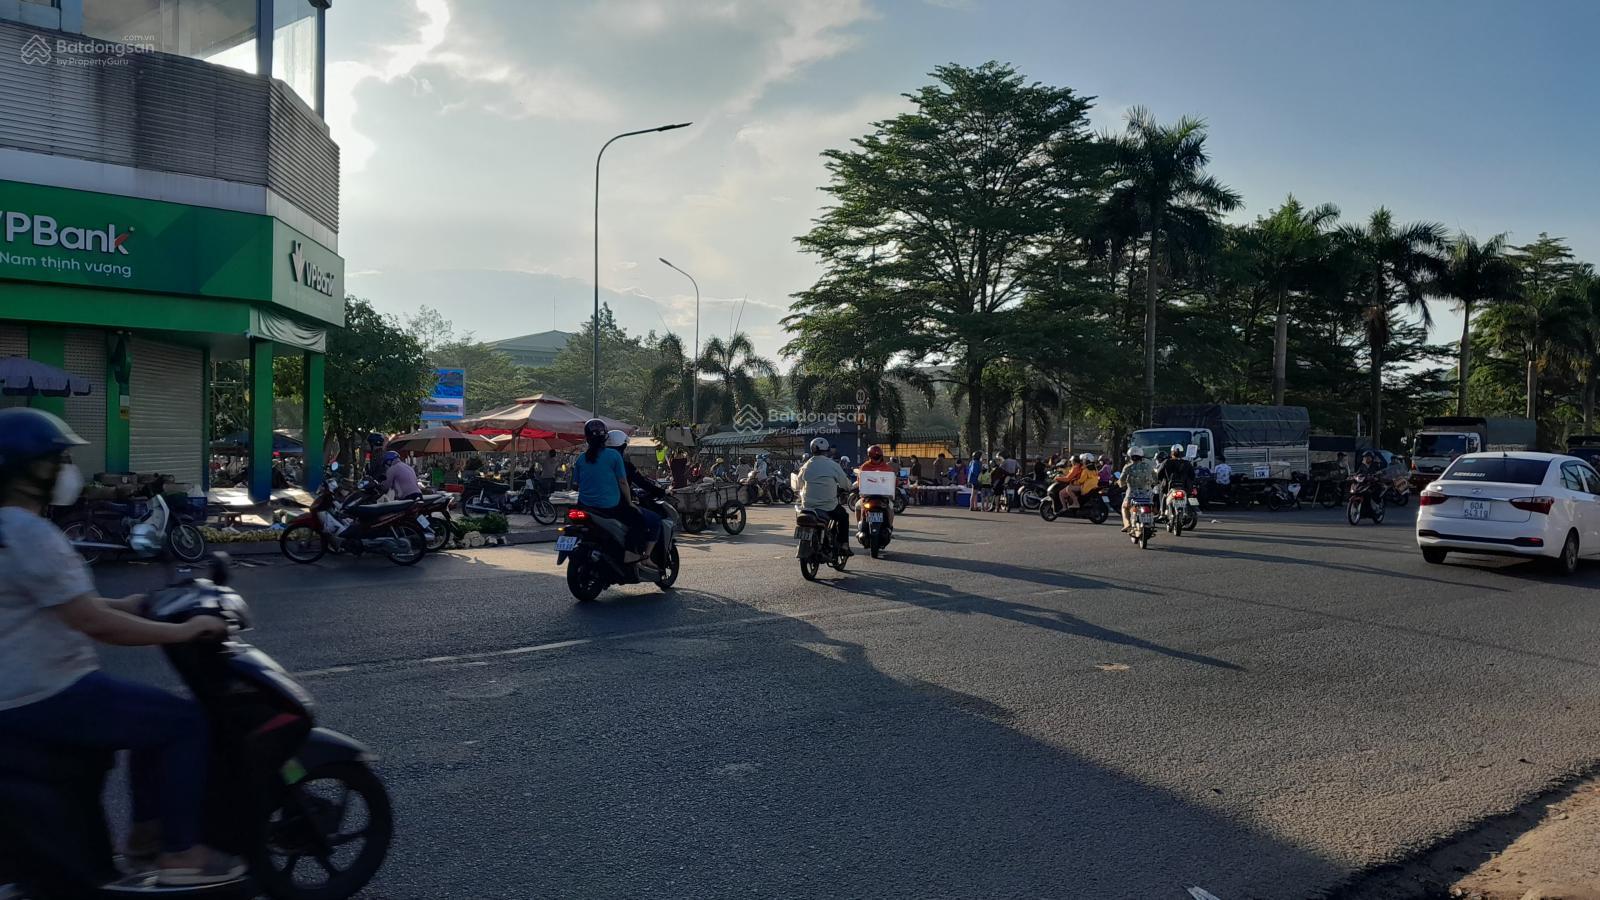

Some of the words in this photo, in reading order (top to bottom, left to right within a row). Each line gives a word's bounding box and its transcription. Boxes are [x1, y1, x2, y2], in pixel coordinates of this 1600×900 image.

[0, 210, 129, 255] PBank
[41, 256, 80, 271] thịnh
[85, 261, 131, 278] vượng
